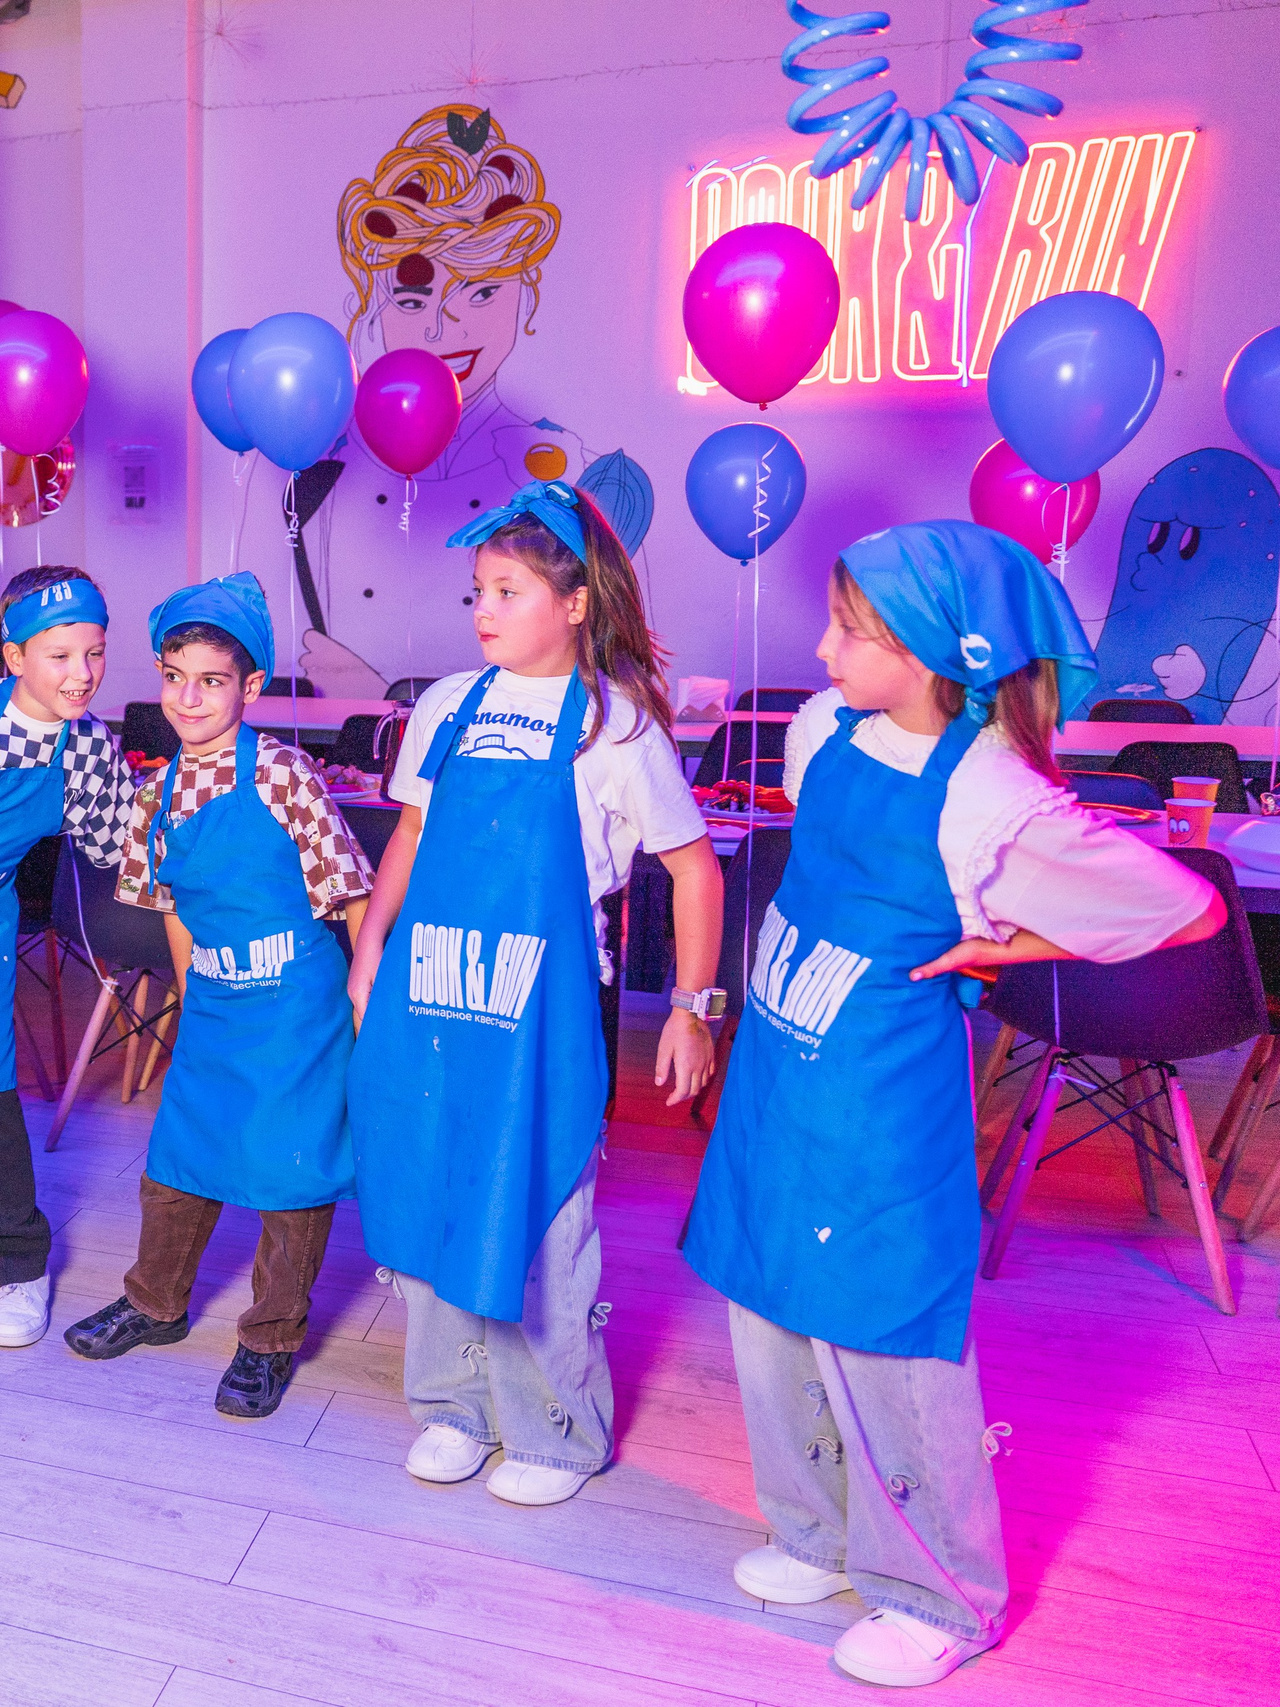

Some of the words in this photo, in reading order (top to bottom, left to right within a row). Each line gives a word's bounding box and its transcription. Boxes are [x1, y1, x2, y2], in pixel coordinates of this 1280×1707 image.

[238, 930, 295, 981] RUN
[409, 921, 464, 1009] COOK
[465, 929, 487, 1012] &
[486, 932, 548, 1020] RUN
[766, 925, 800, 1015] &
[779, 938, 873, 1036] RUN
[408, 1004, 473, 1021] кулинарное
[474, 1013, 519, 1033] квест-шоу
[767, 1013, 823, 1049] квест-шоу
